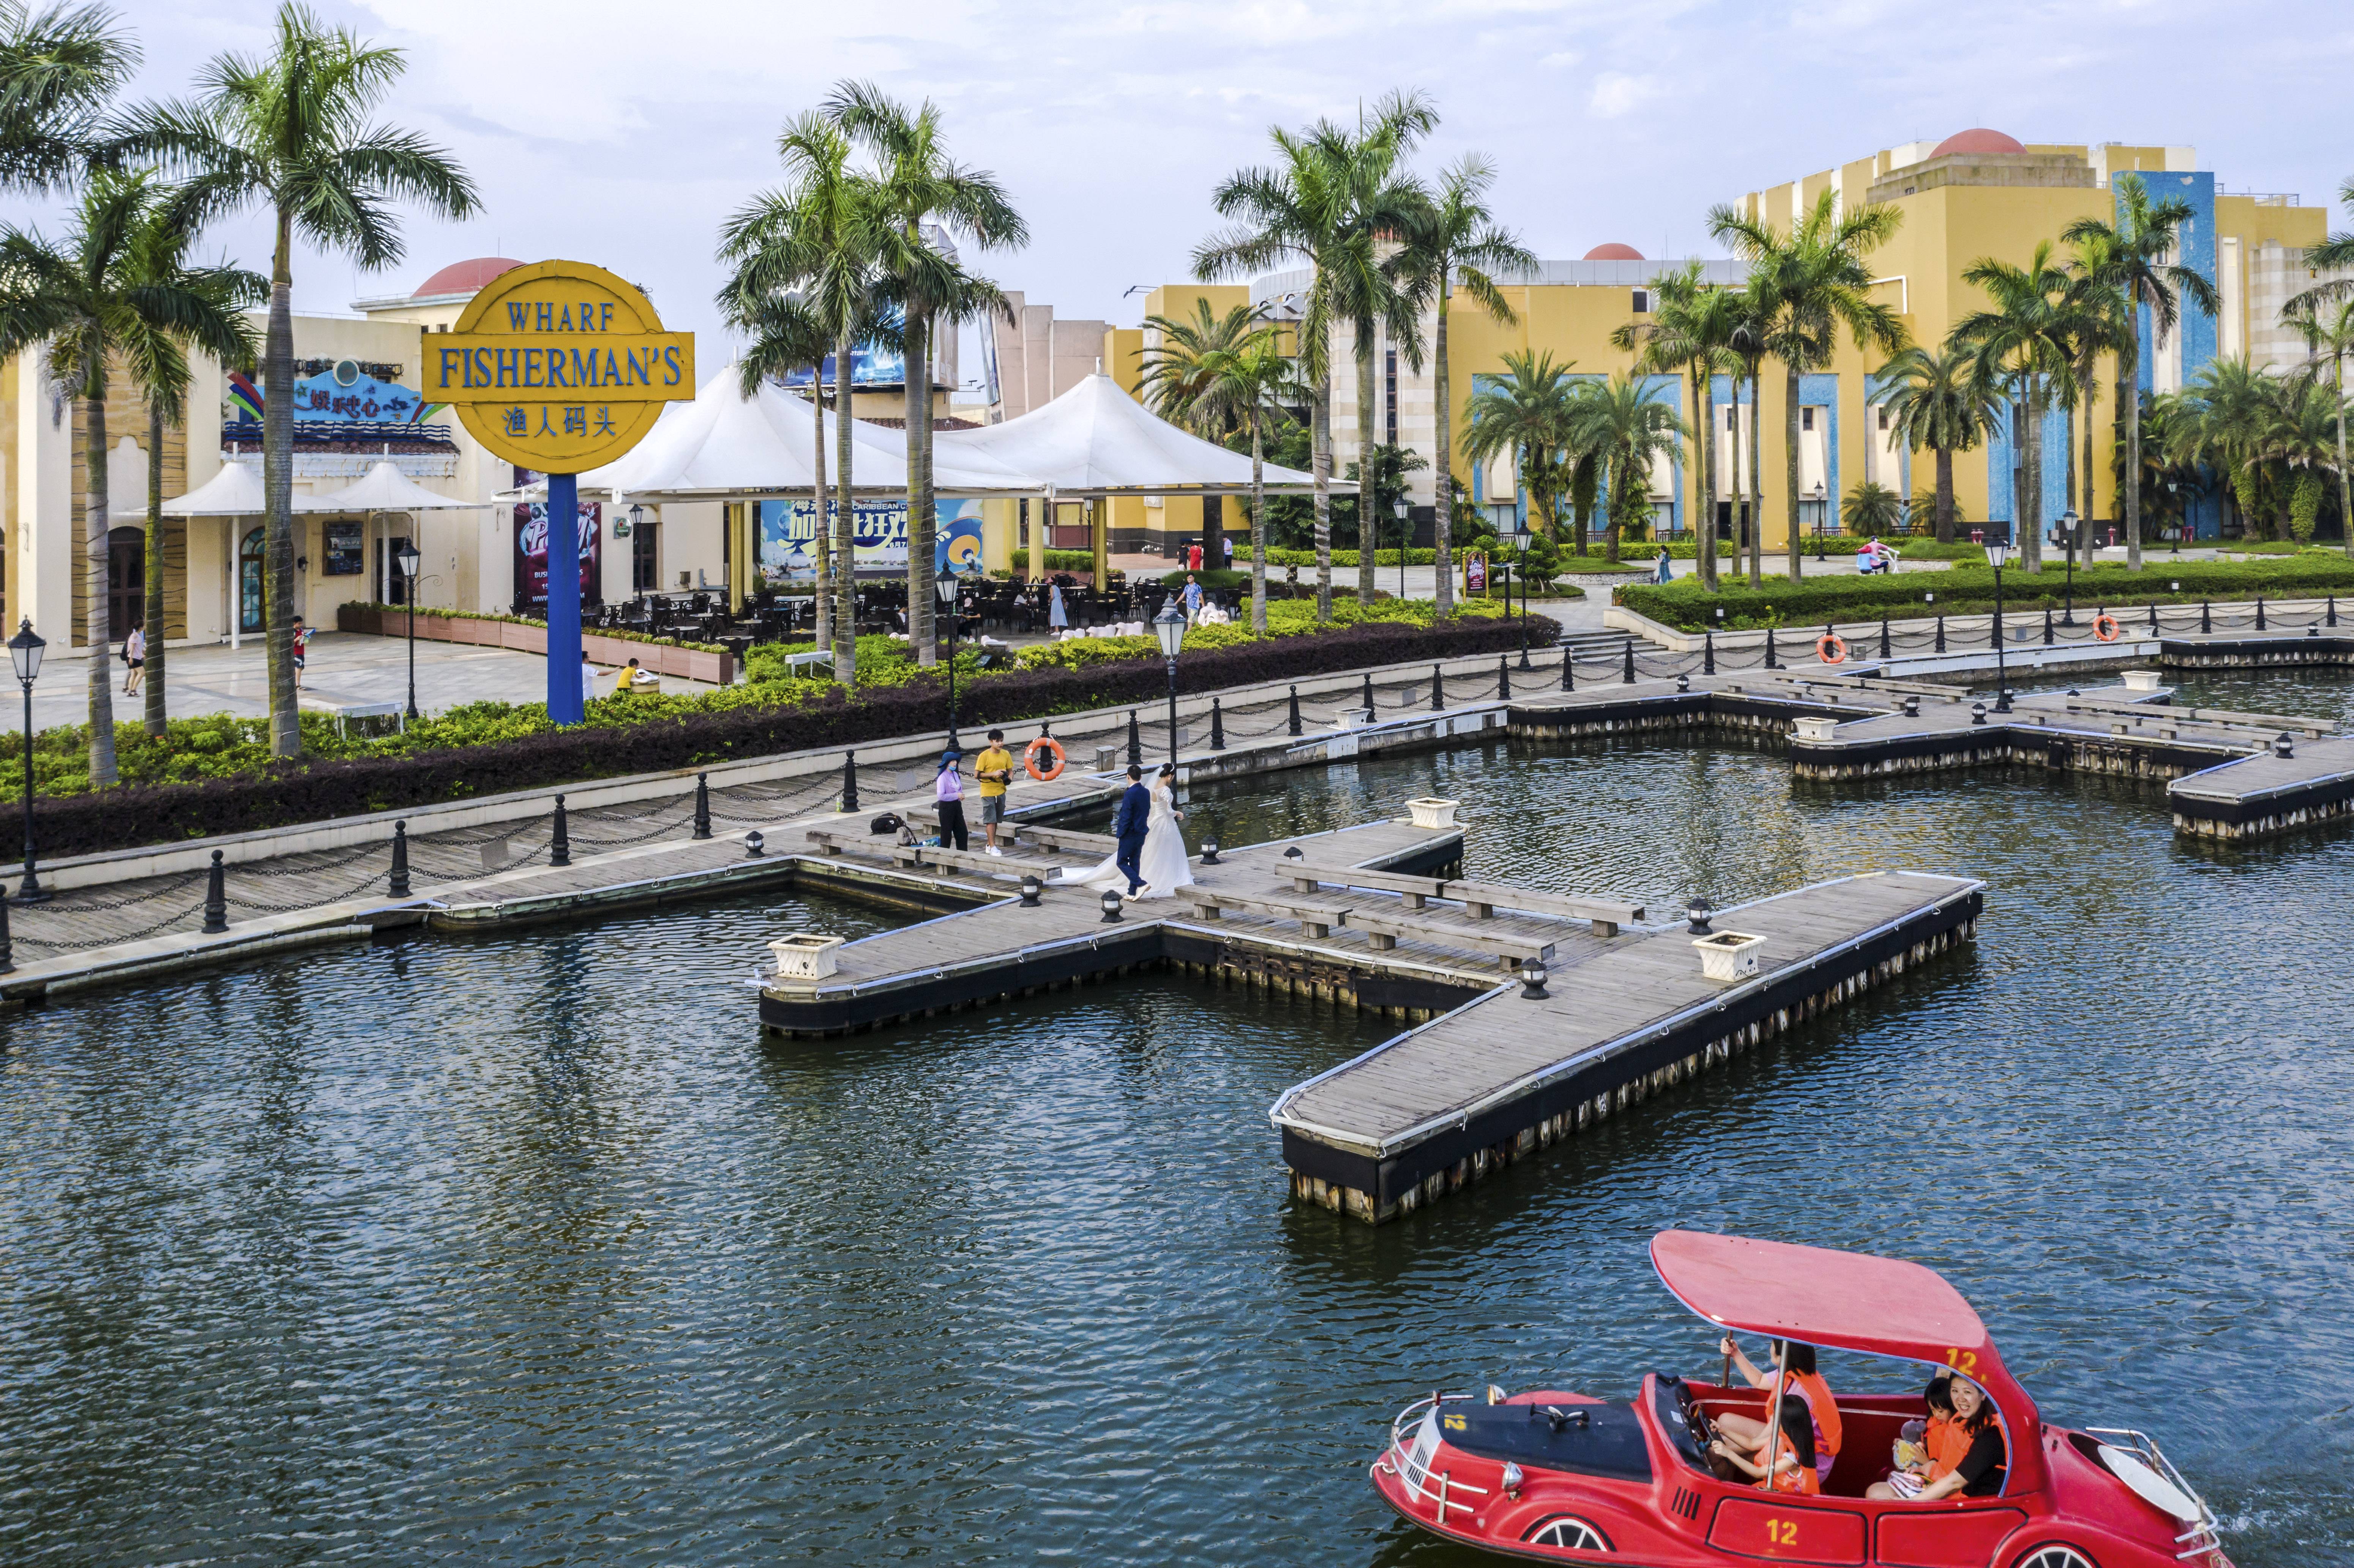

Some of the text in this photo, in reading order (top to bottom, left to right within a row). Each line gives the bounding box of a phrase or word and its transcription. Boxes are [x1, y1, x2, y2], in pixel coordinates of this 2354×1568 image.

[506, 301, 614, 331] WHARF
[439, 345, 681, 388] FISHERMAN'S
[311, 389, 380, 418] 娱乐中心
[502, 405, 616, 437] 渔人码头
[1946, 1348, 1977, 1376] 12
[1444, 1414, 1467, 1431] 12
[1767, 1519, 1797, 1545] 12
